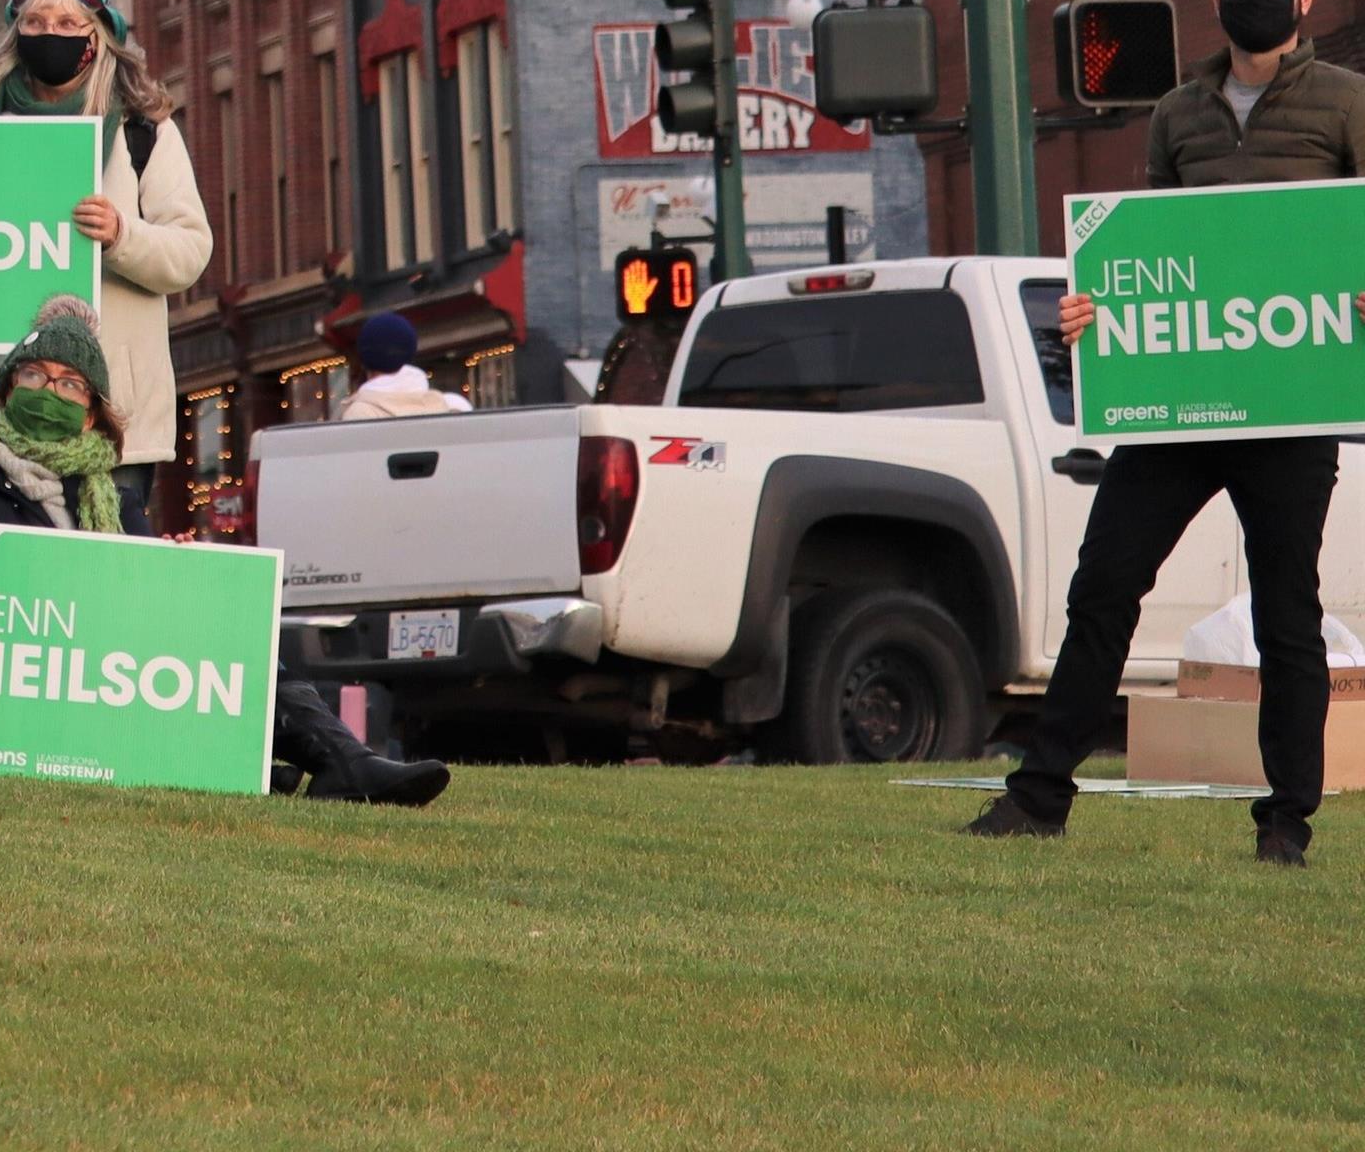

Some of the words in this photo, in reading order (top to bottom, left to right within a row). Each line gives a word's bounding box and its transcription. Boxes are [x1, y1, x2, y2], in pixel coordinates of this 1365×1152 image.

[1075, 201, 1109, 239] ELECT
[672, 261, 693, 307] 0
[1092, 256, 1195, 297] JENN
[1096, 293, 1353, 357] NEILSON
[1104, 405, 1169, 426] greens
[1176, 410, 1248, 425] FURSTENAU
